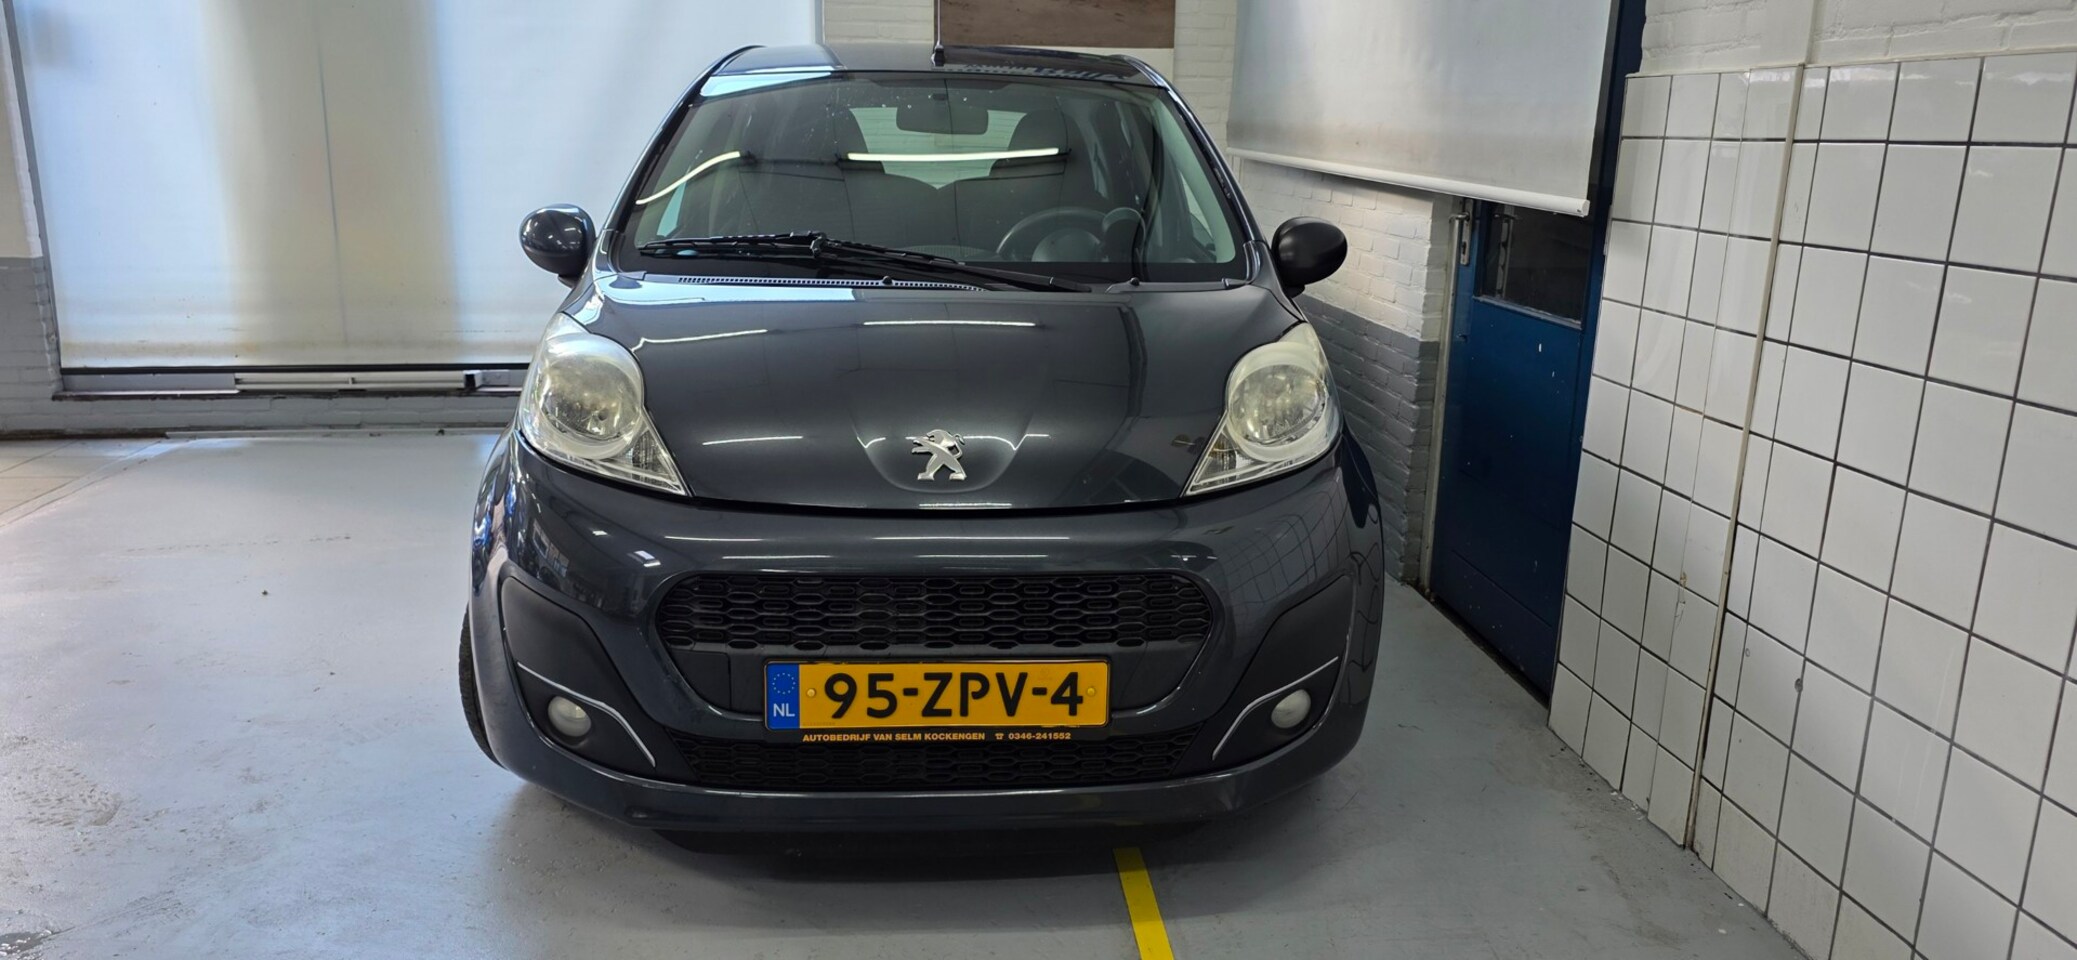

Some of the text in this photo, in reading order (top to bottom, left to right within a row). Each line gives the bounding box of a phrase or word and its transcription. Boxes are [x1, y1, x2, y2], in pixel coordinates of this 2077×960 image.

[823, 671, 1084, 719] 95-ZPV-4
[772, 702, 796, 717] NL
[802, 731, 1071, 742] AUTOBEDRIJF VAN SELM KOCKENGEN 0346-241552
